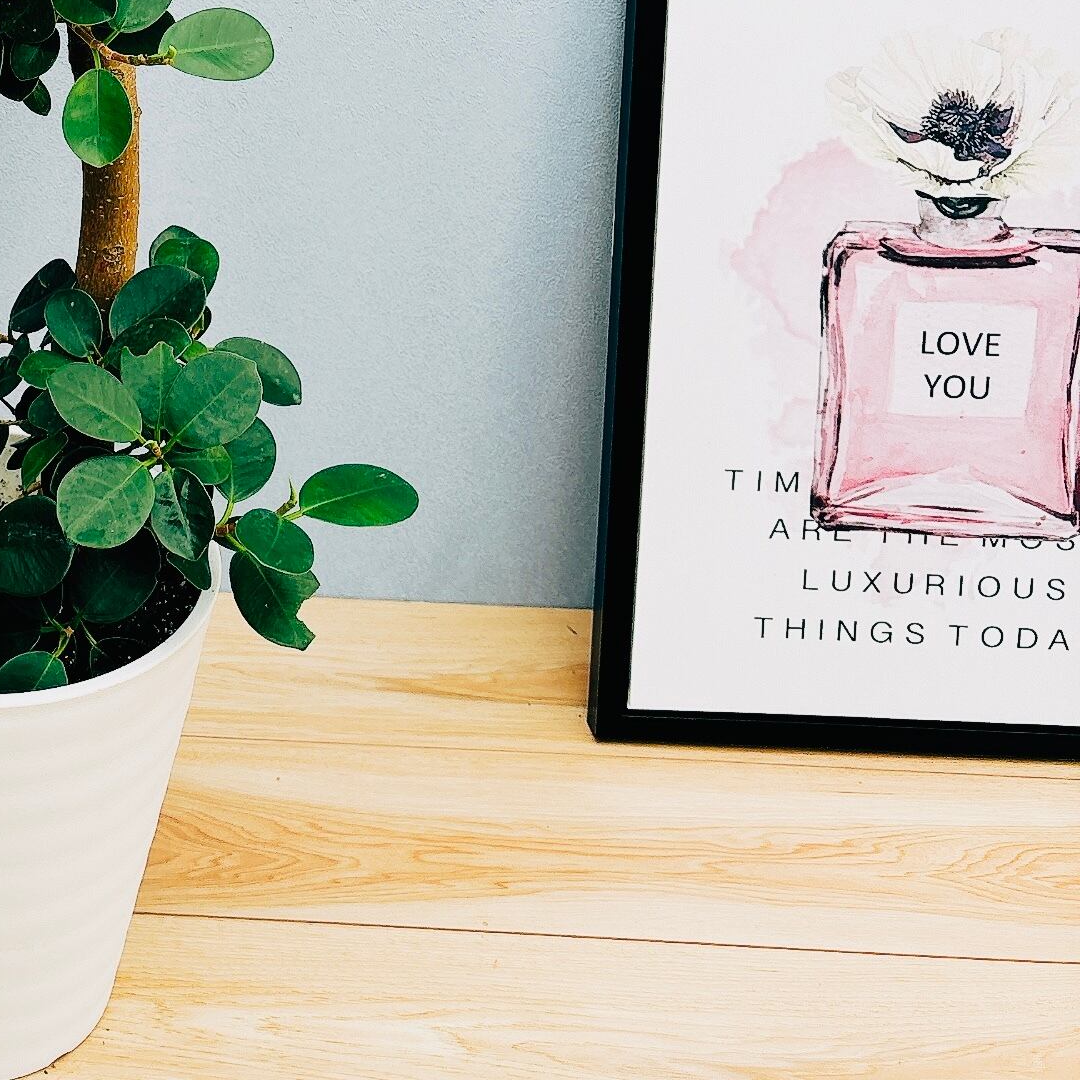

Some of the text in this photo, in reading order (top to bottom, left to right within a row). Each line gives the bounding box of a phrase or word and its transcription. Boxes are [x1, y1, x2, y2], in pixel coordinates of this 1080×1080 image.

[921, 330, 1002, 357] LOVE
[924, 373, 991, 400] YOU
[802, 568, 1066, 601] LUXURIOUS
[754, 616, 1070, 651] THINGS TODA
